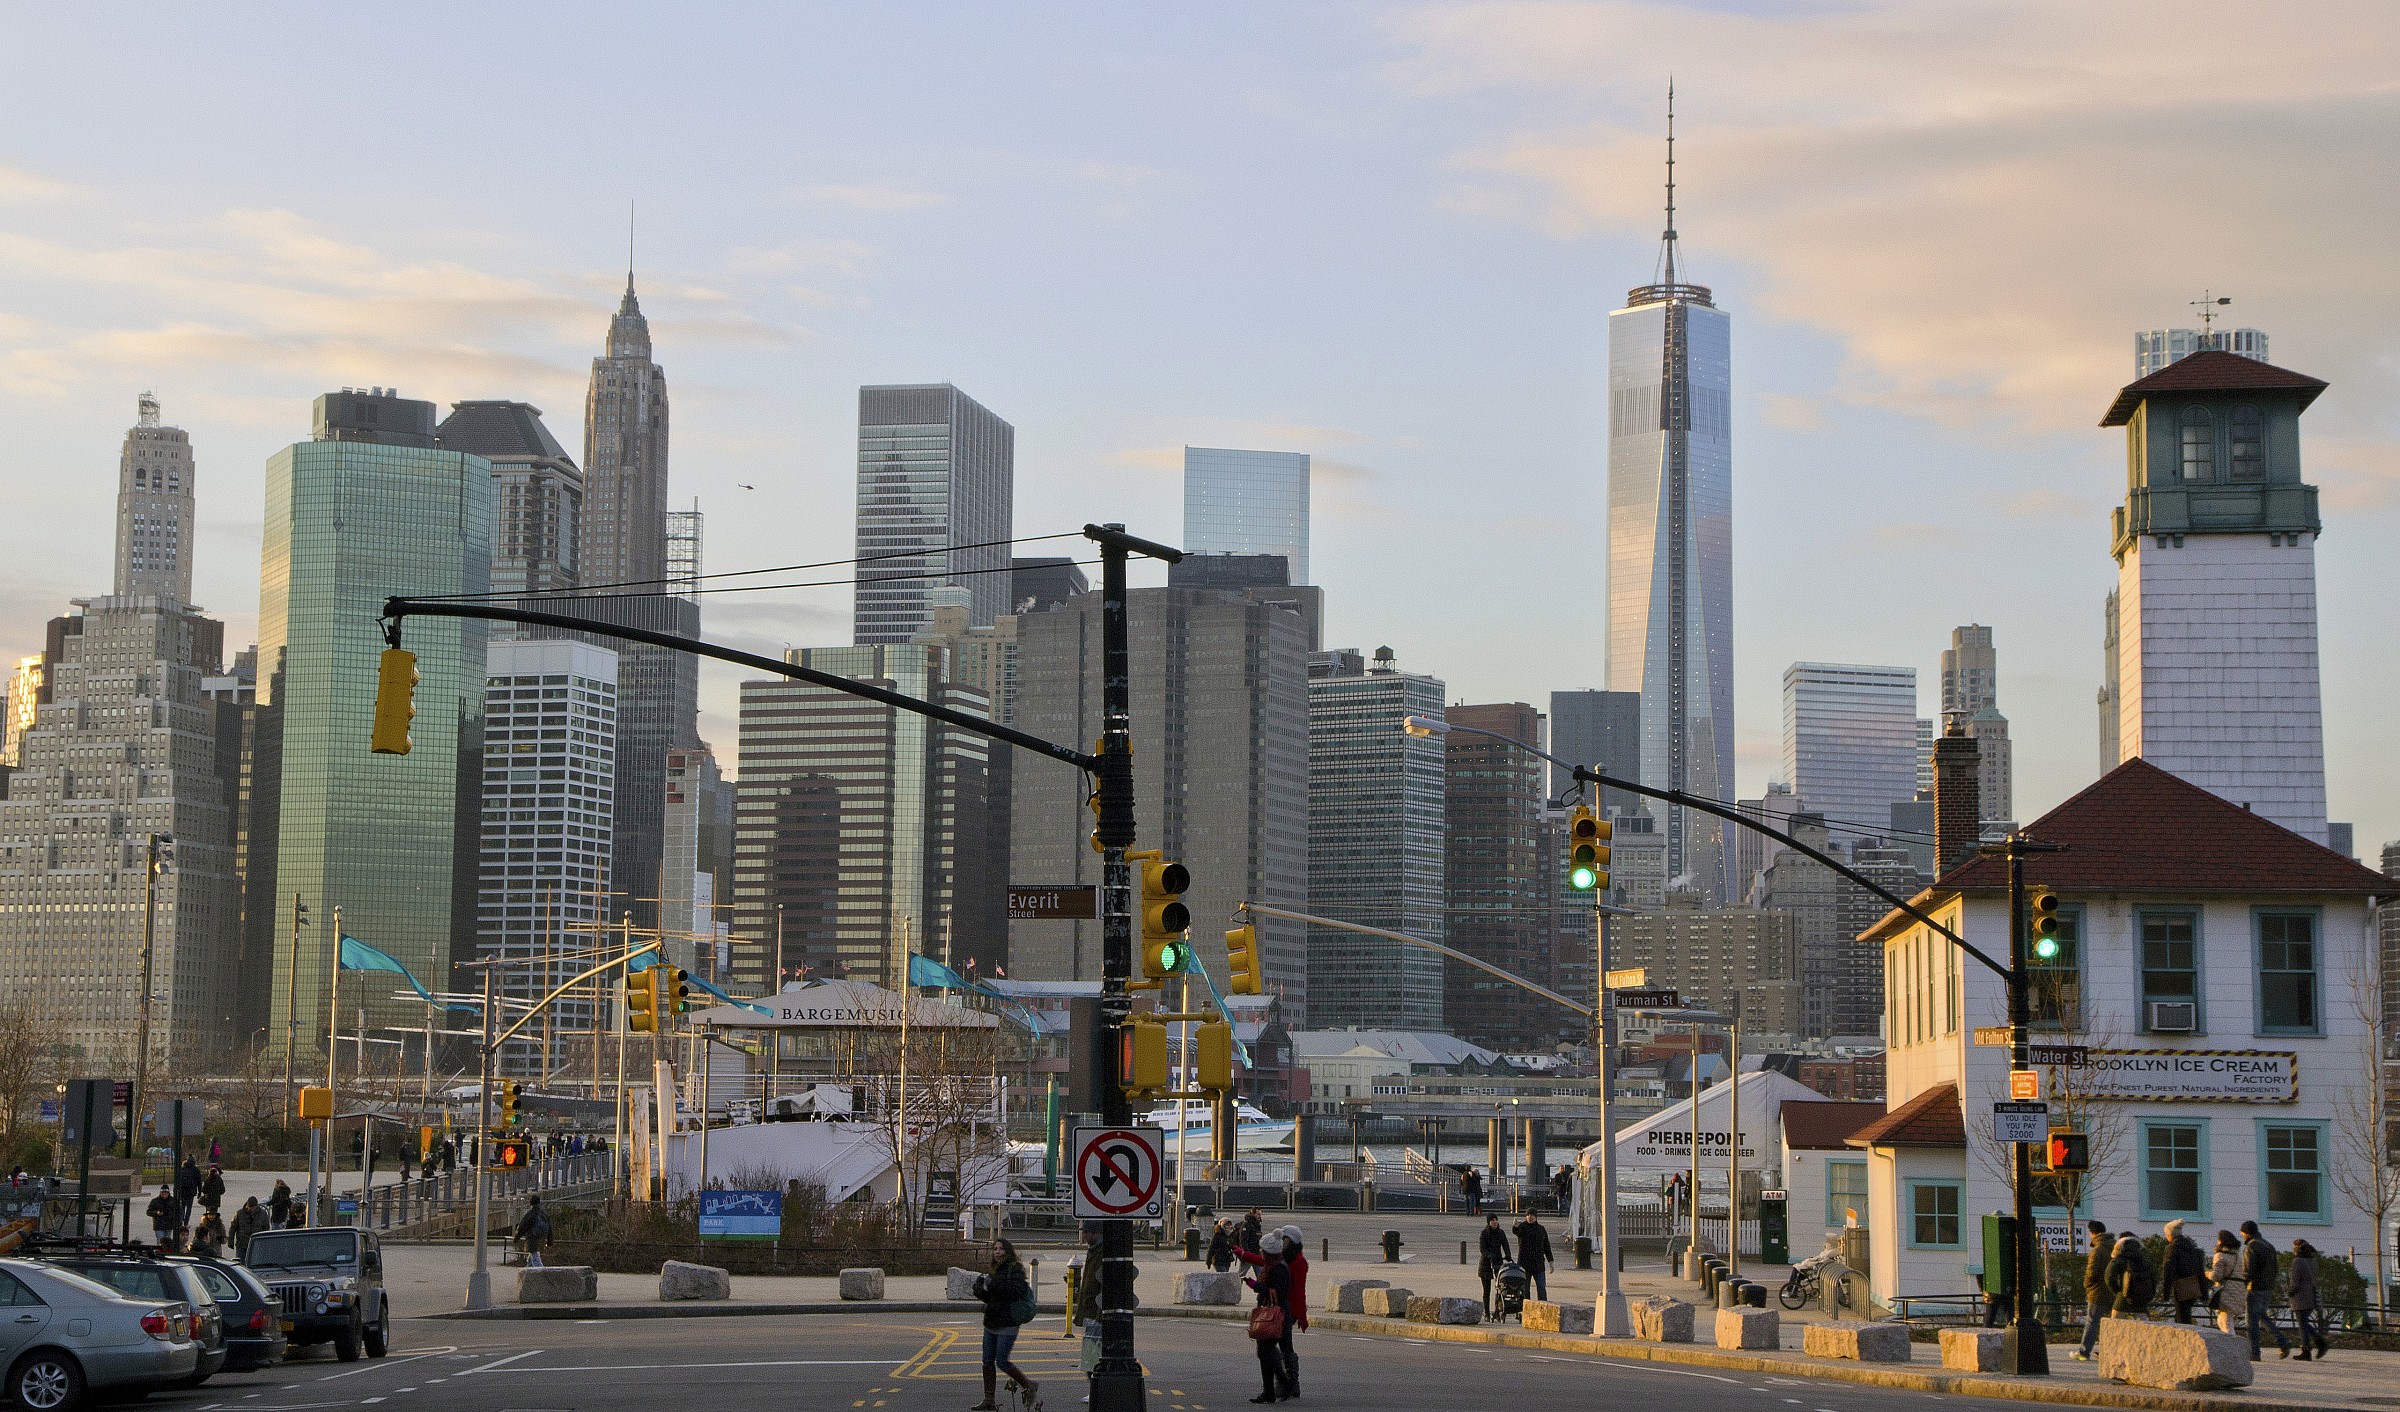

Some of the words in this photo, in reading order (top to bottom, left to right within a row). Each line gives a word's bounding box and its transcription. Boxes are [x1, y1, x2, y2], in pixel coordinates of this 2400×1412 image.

[1008, 892, 1060, 909] Everit
[1008, 909, 1035, 918] Street
[1609, 975, 1618, 987] Old
[1619, 973, 1636, 985] Fulton
[1637, 973, 1643, 985] St
[1616, 995, 1658, 1006] Furman
[1662, 995, 1673, 1006] St
[1974, 1031, 1984, 1045] Old
[1985, 1031, 2004, 1045] Fulton
[2004, 1031, 2012, 1045] St
[2030, 1050, 2068, 1063] Water
[2072, 1050, 2085, 1064] St
[2174, 1058, 2205, 1072] ICE
[2210, 1059, 2279, 1073] CREAM
[2234, 1074, 2288, 1084] FACTORY
[2092, 1084, 2109, 1092] THE
[2181, 1085, 2223, 1093] NATURAL
[2224, 1085, 2281, 1094] INGREDIENTS
[1648, 1131, 1747, 1146] PIERREPONT
[2009, 1130, 2034, 1139] $2000
[1636, 1147, 1656, 1156] FOOD
[1664, 1147, 1691, 1156] DRINKS
[1700, 1148, 1712, 1157] ICE
[1714, 1149, 1732, 1157] COLD
[1765, 1192, 1783, 1200] ATM
[703, 1218, 725, 1226] PARK
[2051, 1237, 2084, 1247] CREM
